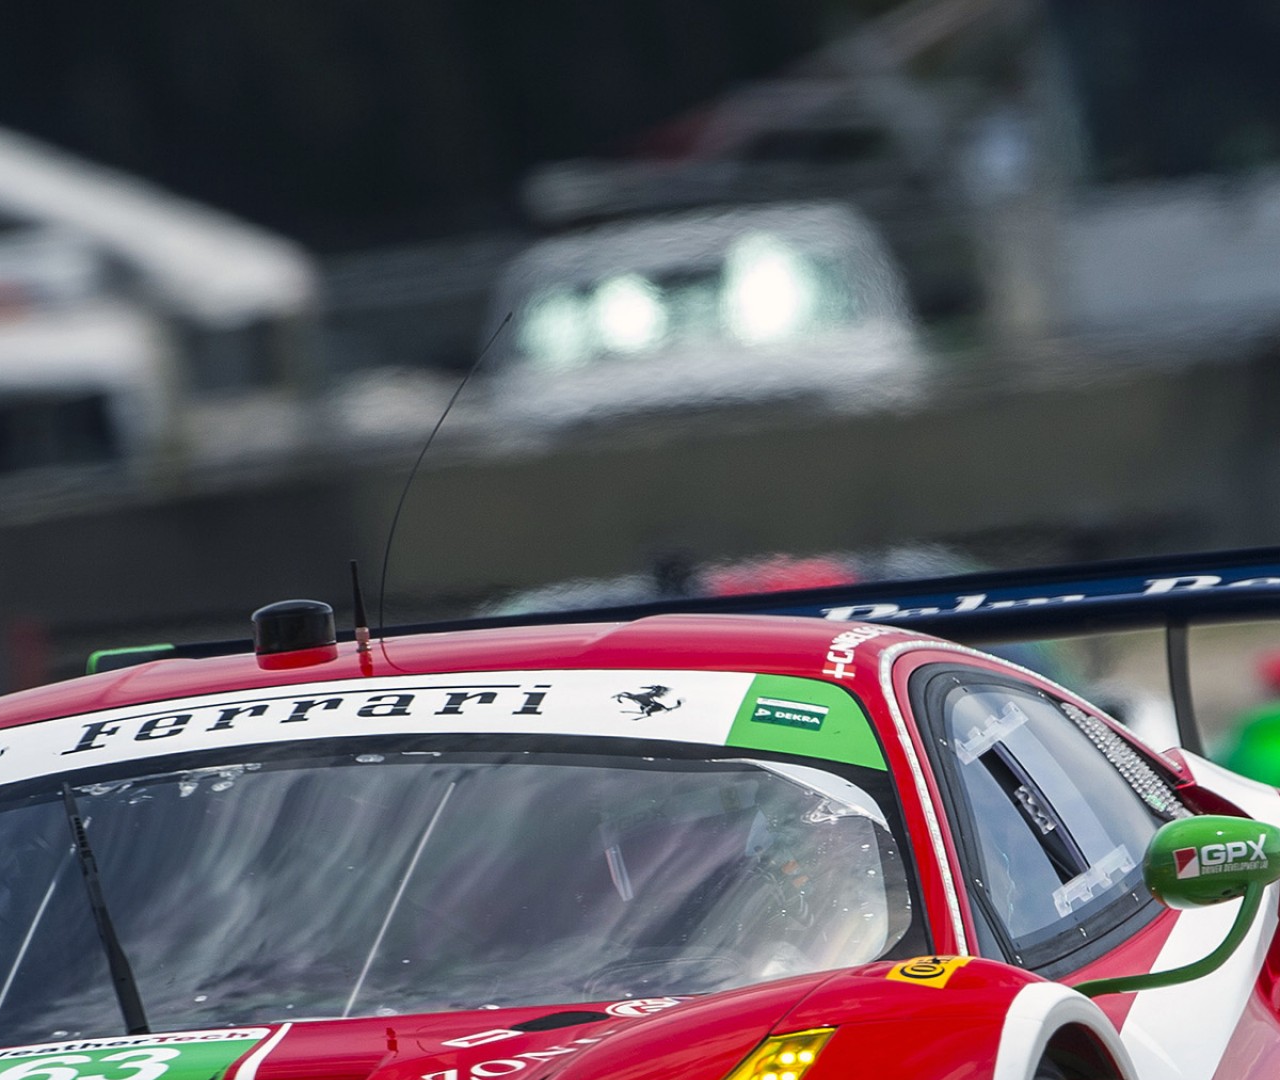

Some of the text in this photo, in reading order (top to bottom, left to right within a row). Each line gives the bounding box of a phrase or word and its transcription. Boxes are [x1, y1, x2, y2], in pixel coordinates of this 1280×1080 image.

[60, 684, 552, 755] Ferrari
[775, 711, 820, 725] DEKRA
[1200, 834, 1267, 866] GPX
